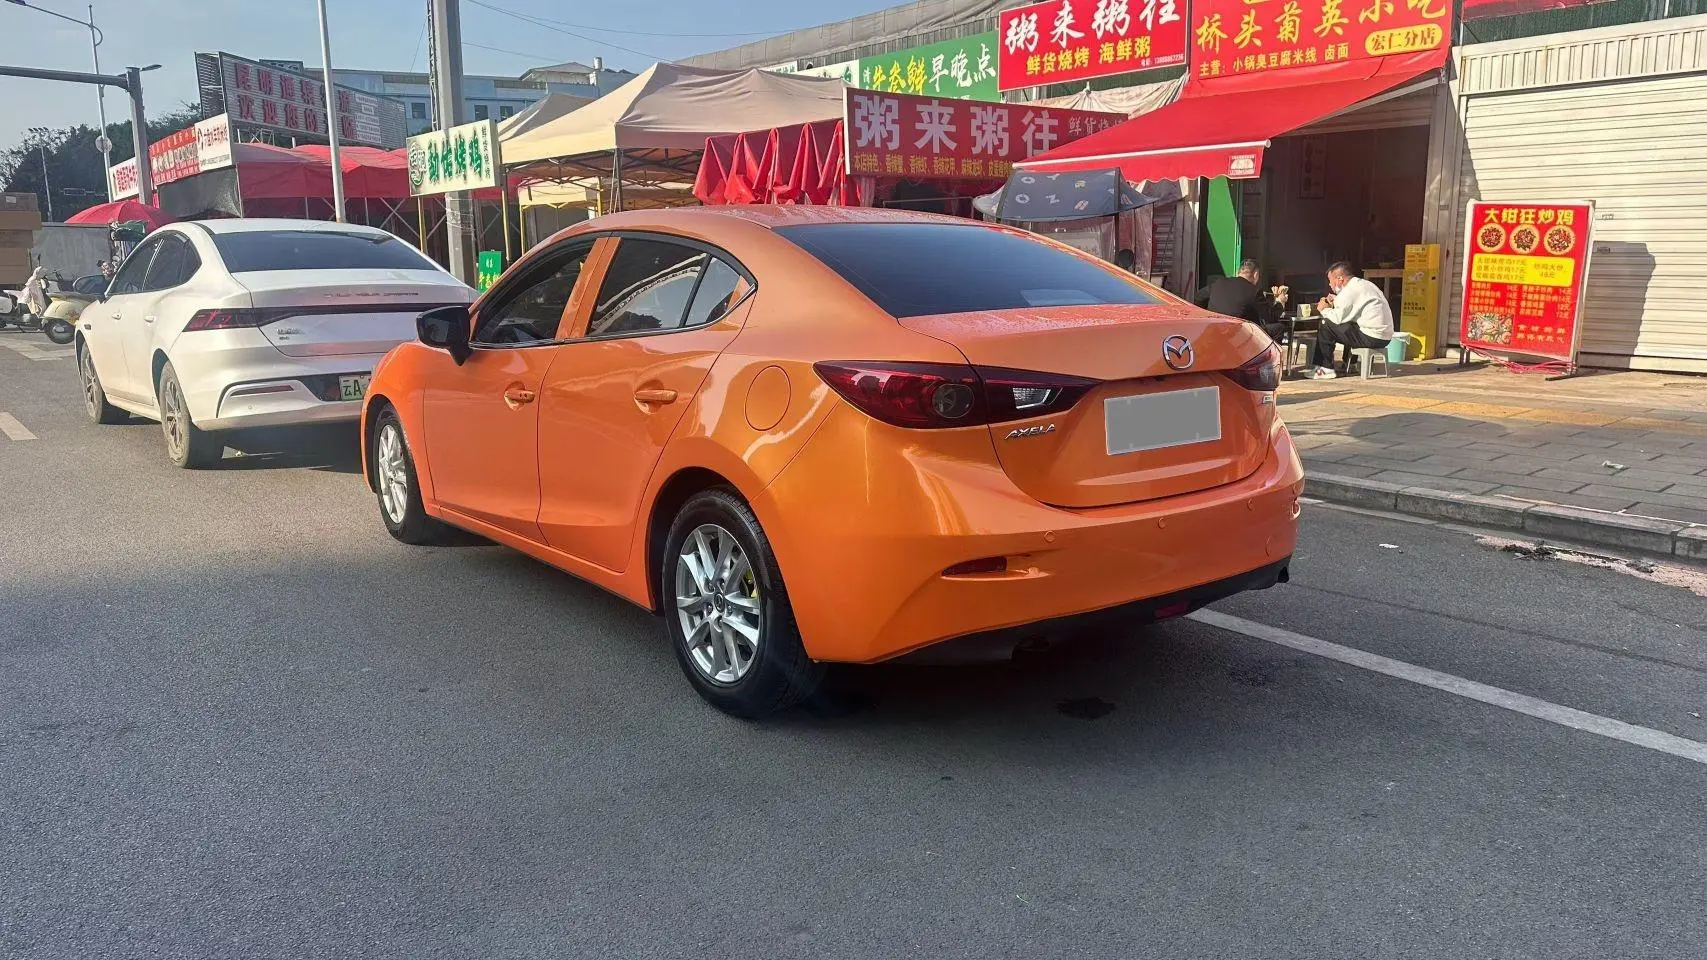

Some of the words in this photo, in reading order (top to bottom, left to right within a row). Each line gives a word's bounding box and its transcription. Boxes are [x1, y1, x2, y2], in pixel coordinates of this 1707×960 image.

[1004, 0, 1181, 55] 粥来粥往
[1372, 27, 1436, 51] 宏仁分店
[1025, 46, 1090, 76] 鲜货烧烤
[1099, 36, 1151, 64] 海鲜粥
[1233, 47, 1317, 72] 小锅臭豆腐米线
[1325, 42, 1349, 61] 卤面
[238, 95, 357, 140] 欢迎您的临
[854, 94, 1058, 160] 粥来粥往
[1004, 423, 1056, 440] AXELA
